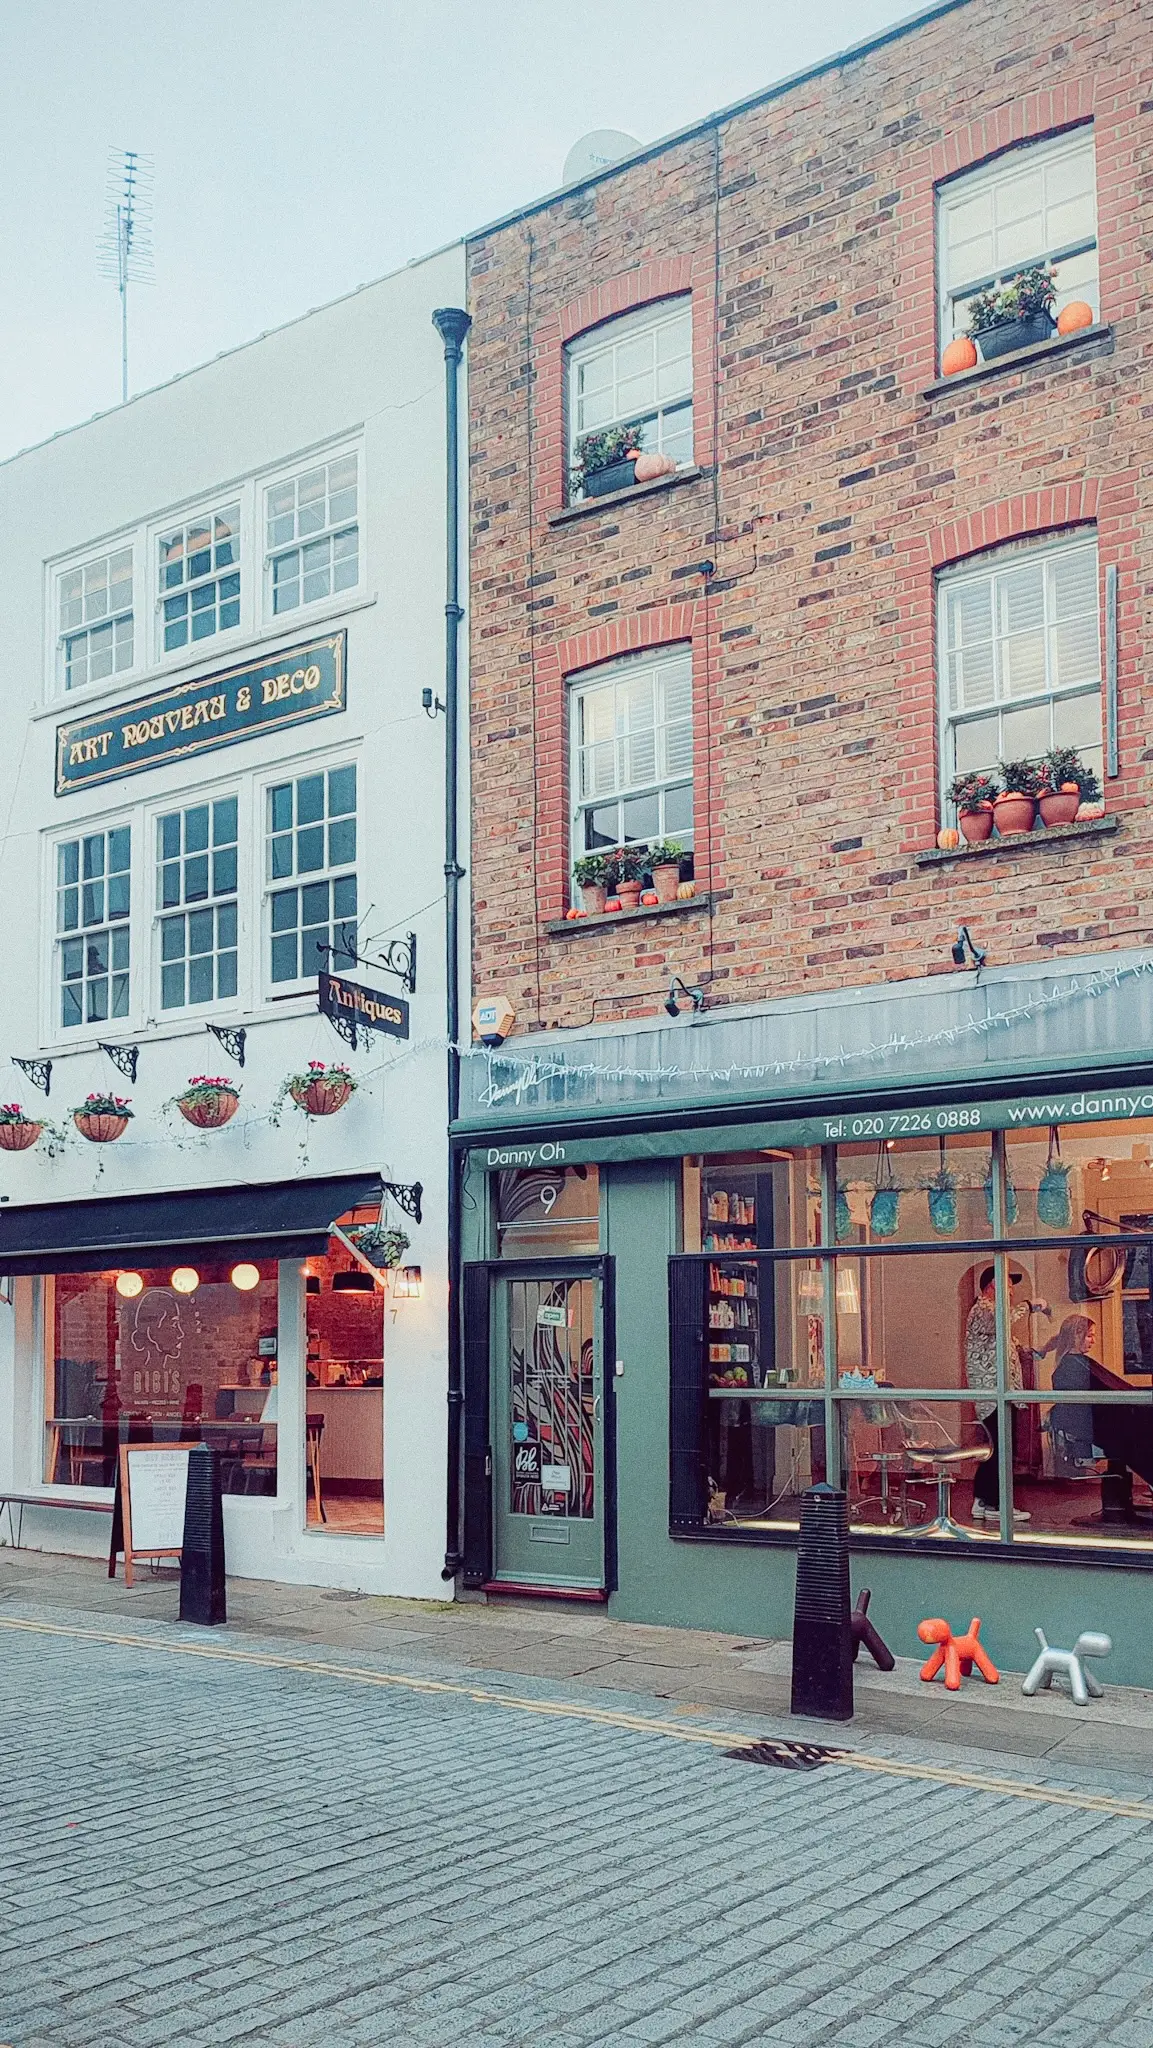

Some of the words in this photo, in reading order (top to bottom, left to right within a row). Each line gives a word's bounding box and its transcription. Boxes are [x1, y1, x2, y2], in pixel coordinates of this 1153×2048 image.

[69, 731, 113, 765] ART
[122, 694, 226, 749] NOUVEAU
[236, 686, 251, 712] &
[261, 665, 321, 704] DECO
[328, 980, 402, 1025] Antiques
[480, 1010, 497, 1021] ADT
[823, 1122, 847, 1138] Tel:
[852, 1117, 884, 1136] 020
[889, 1114, 931, 1133] 7226
[936, 1109, 981, 1129] 0888
[487, 1148, 536, 1167] Danny
[540, 1142, 565, 1161] Oh
[541, 1185, 557, 1214] 9
[390, 1309, 398, 1325] 7
[133, 1368, 180, 1394] BIBI'S
